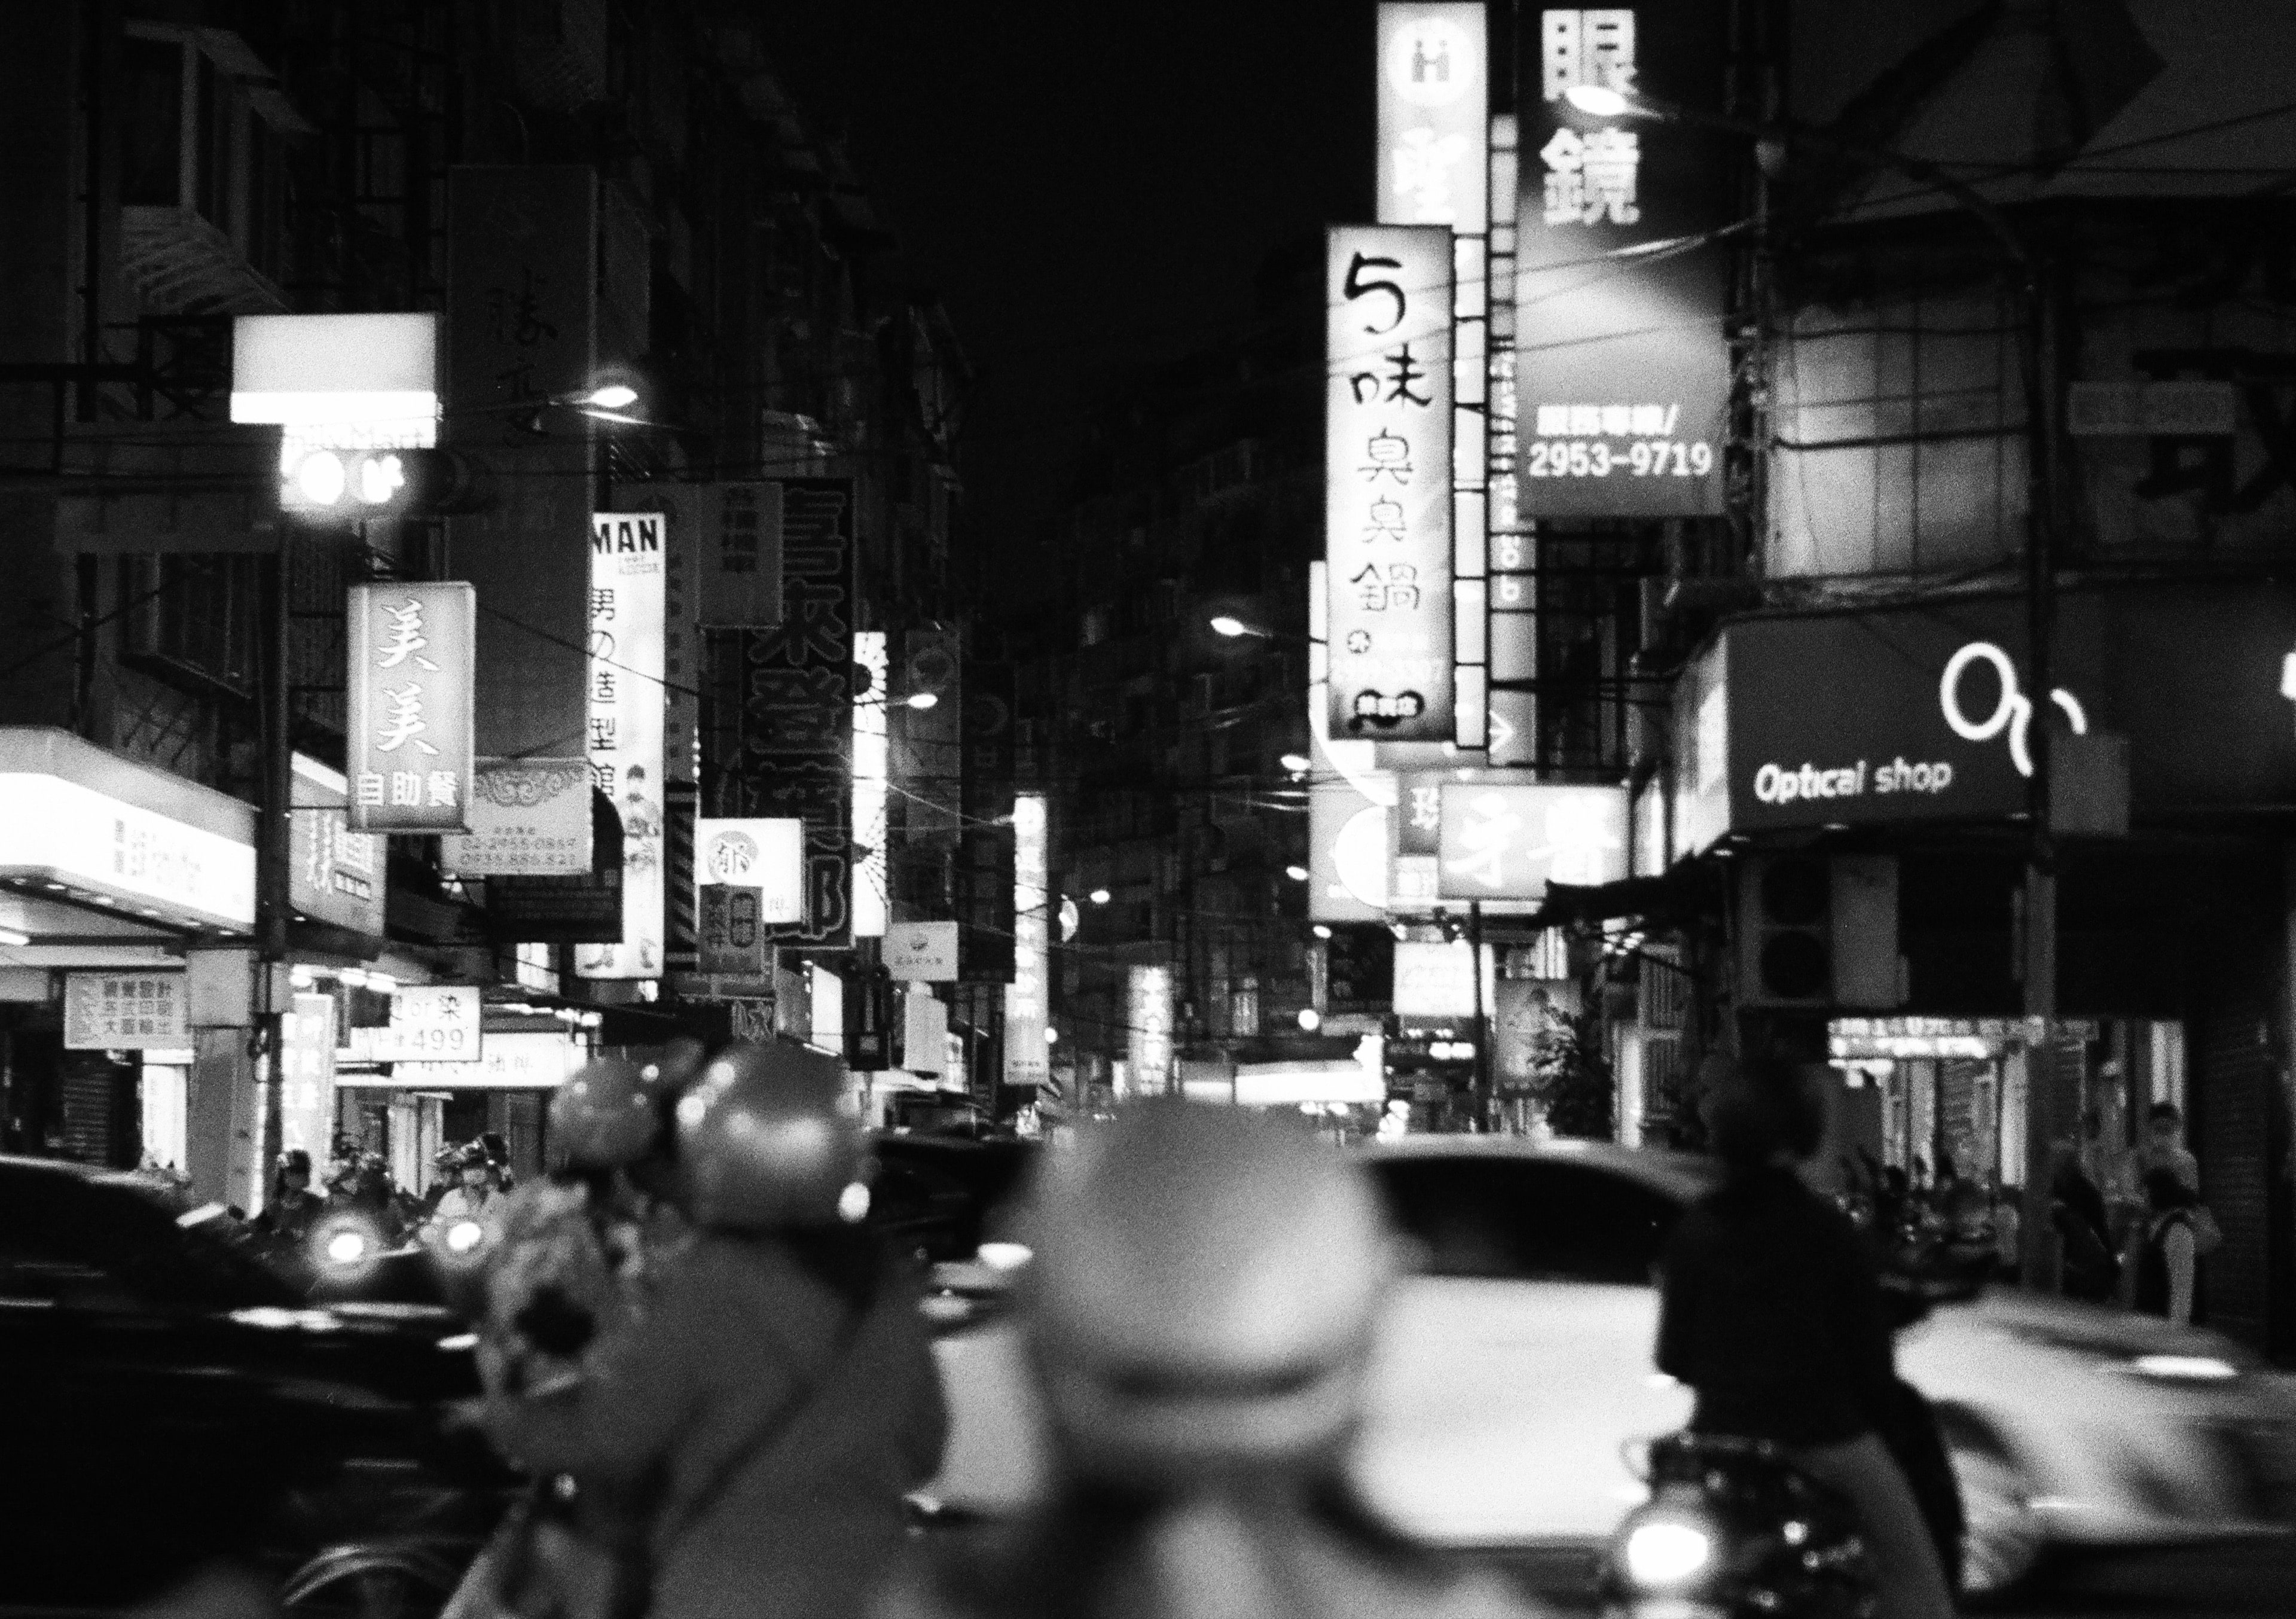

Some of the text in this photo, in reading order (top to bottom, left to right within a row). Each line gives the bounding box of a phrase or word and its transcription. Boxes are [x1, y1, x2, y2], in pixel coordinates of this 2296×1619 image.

[1540, 8, 1641, 227] 眼鏡
[1529, 441, 1712, 477] 2953-9719
[592, 519, 659, 554] MAN
[377, 597, 441, 757] 美美
[356, 771, 457, 808] 自助餐
[1753, 756, 1954, 804] Optical shop
